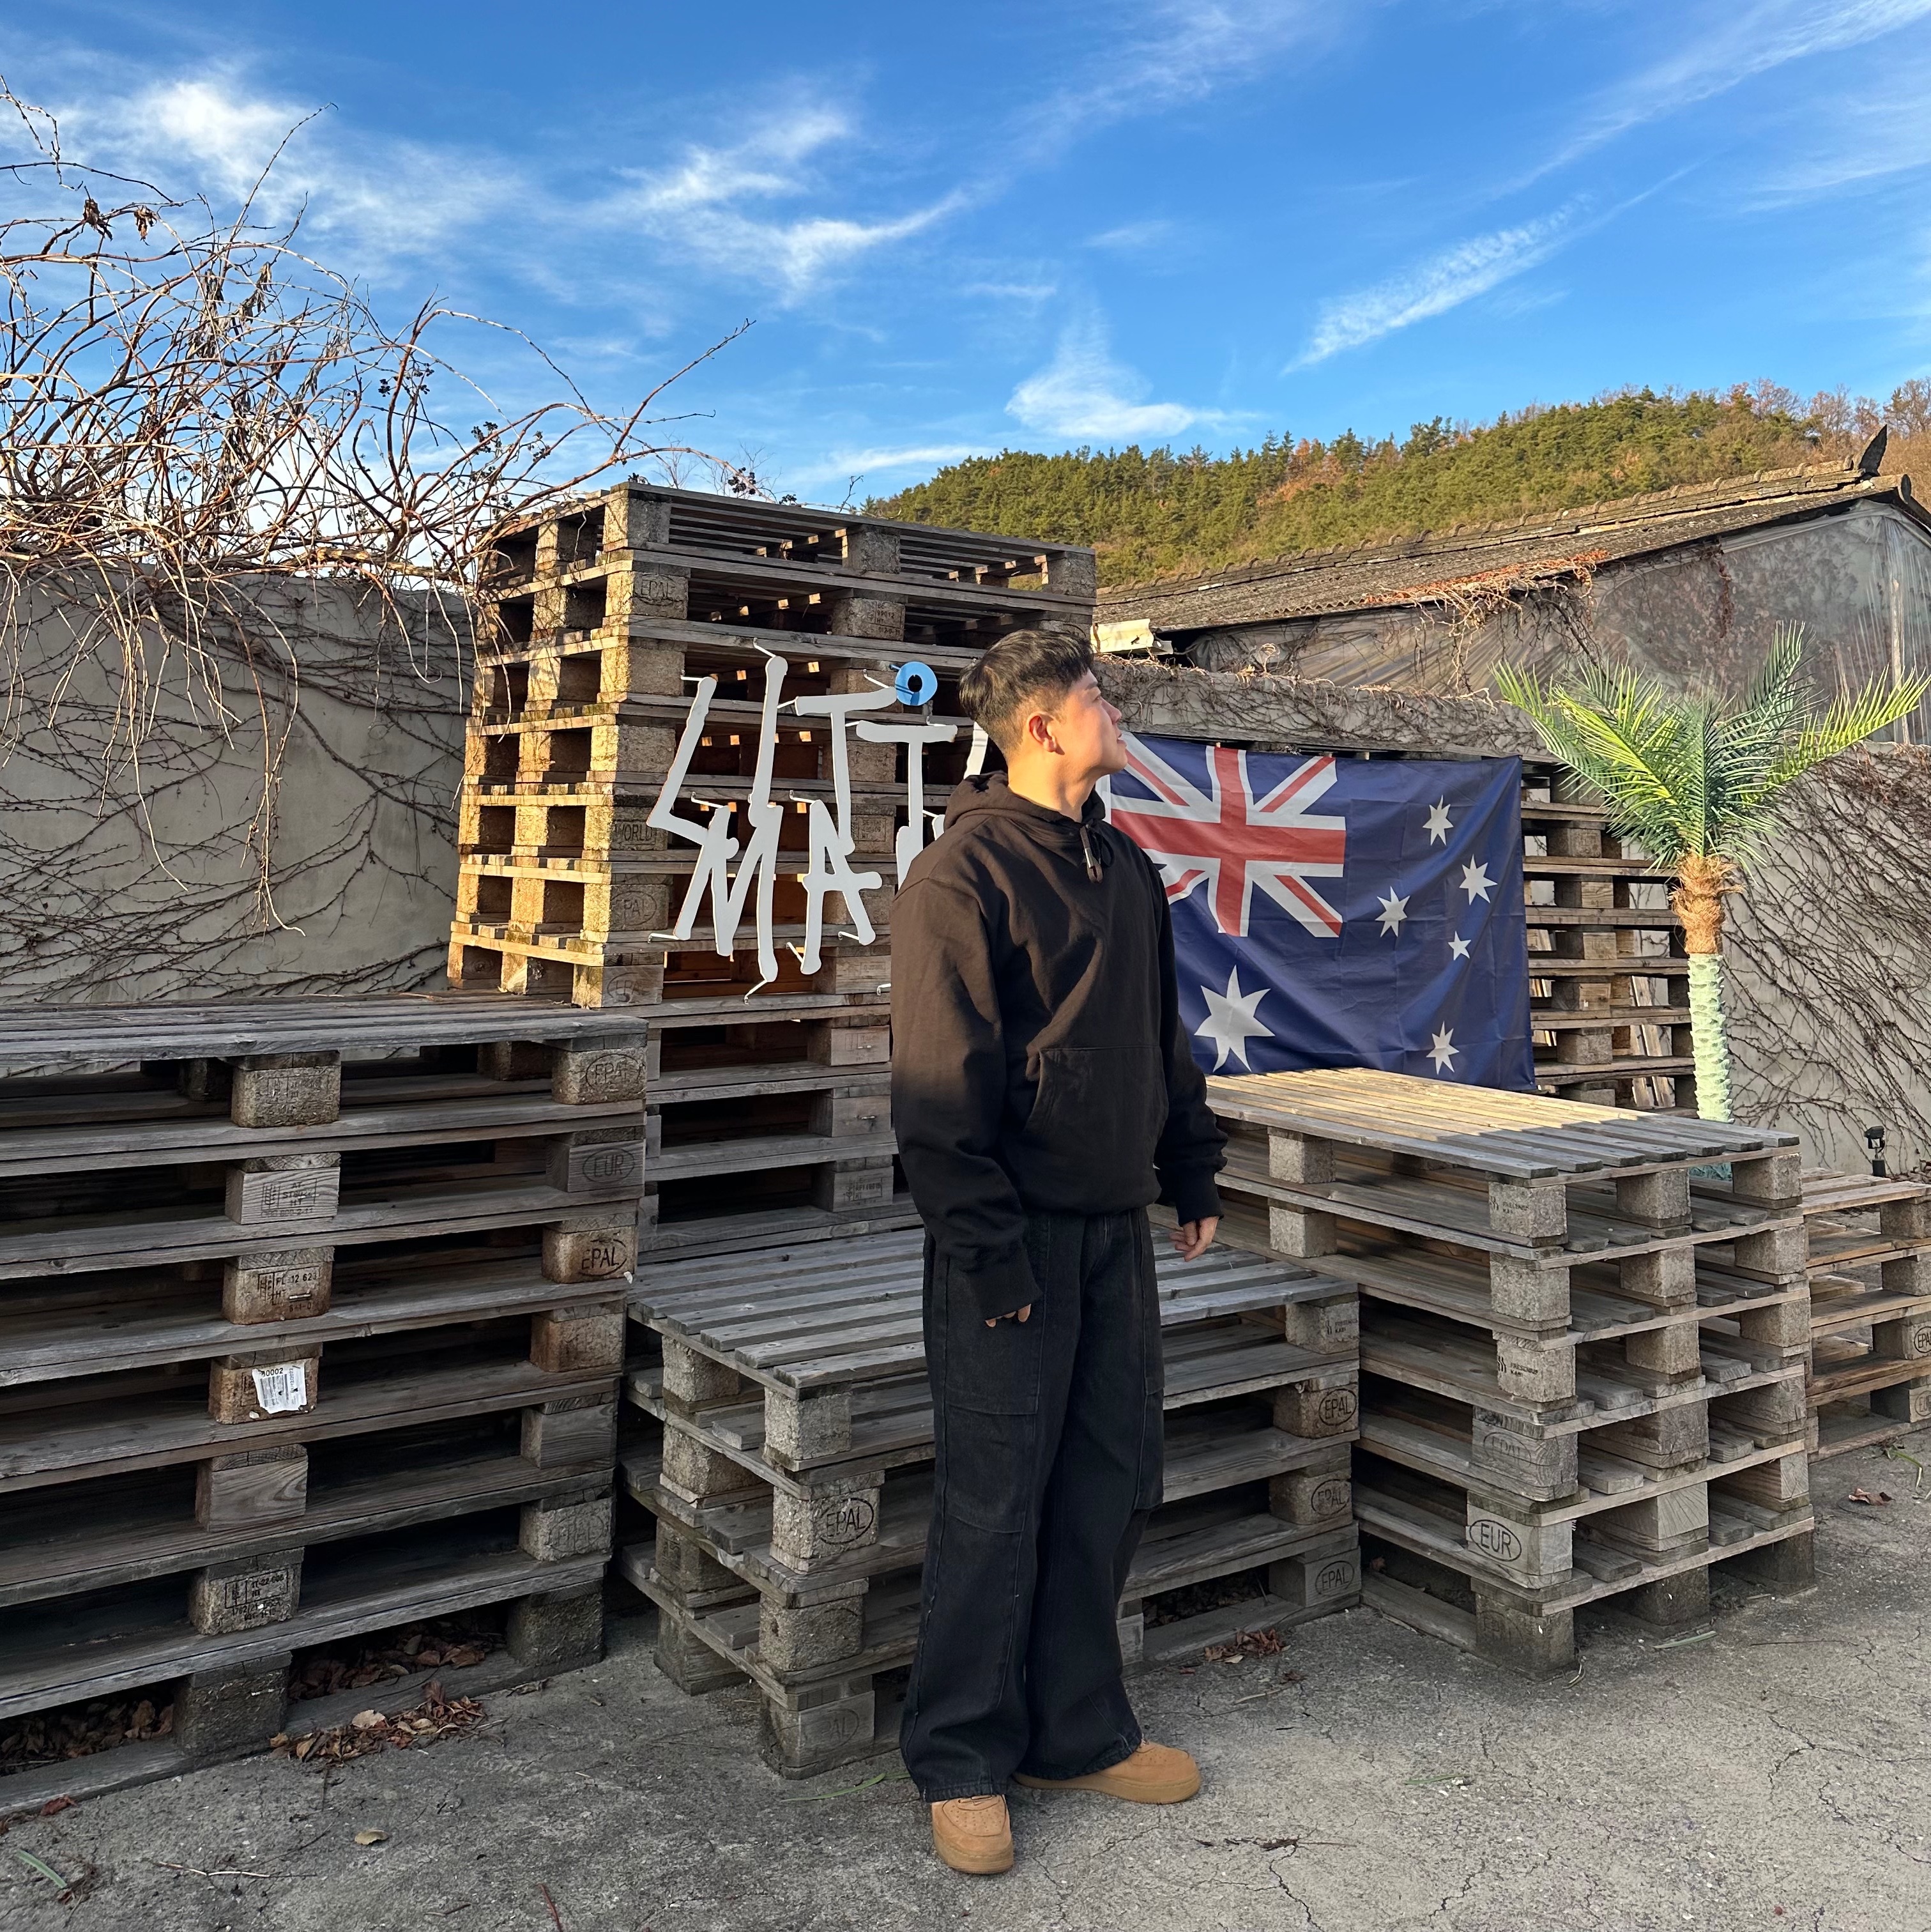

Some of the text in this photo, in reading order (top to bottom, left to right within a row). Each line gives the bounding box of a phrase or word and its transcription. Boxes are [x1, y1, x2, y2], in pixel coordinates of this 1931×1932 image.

[594, 1154, 624, 1177] EUR
[581, 1246, 620, 1270] EPAL
[1325, 1395, 1352, 1420] EPAL
[1317, 1486, 1346, 1509] EPAL
[826, 1506, 866, 1537] EPAL
[1480, 1522, 1512, 1558] EUR
[1321, 1566, 1350, 1591] EPAL
